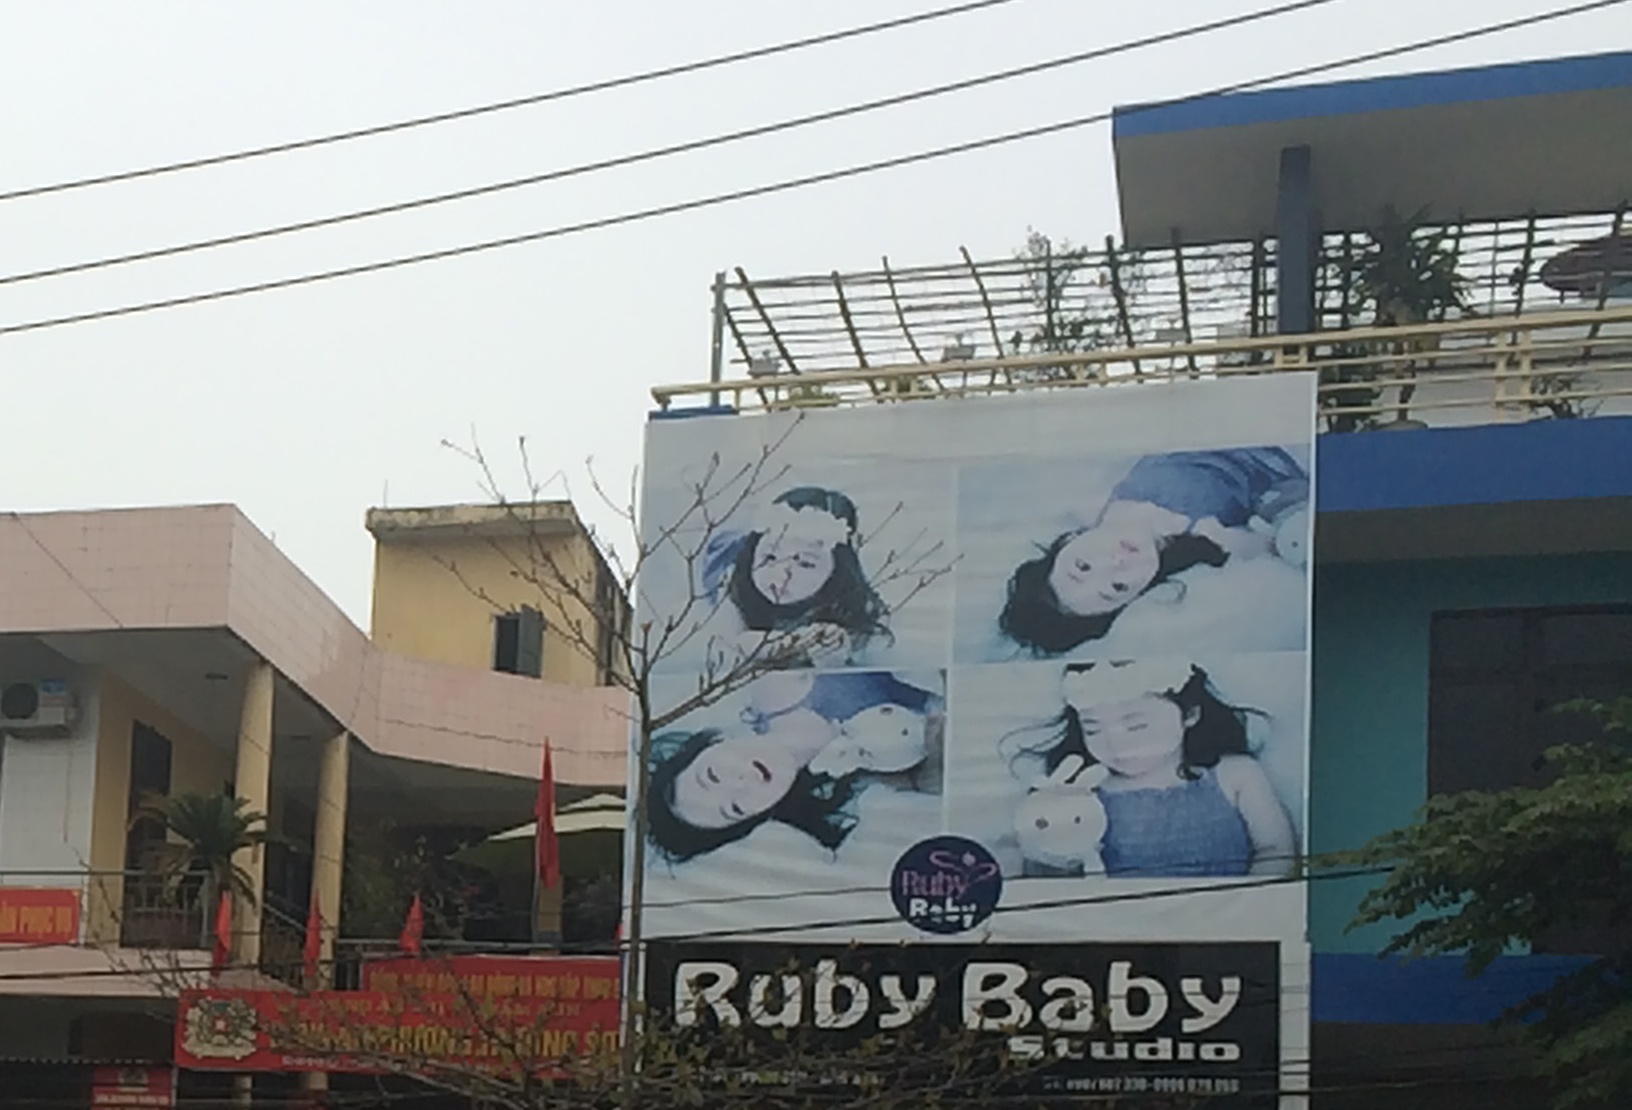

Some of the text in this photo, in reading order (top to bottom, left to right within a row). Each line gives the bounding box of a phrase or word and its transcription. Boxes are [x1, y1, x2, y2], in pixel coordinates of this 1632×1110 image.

[902, 869, 968, 900] Ruby
[674, 958, 1241, 1034] Ruby Baby
[1007, 1036, 1241, 1063] Studio
